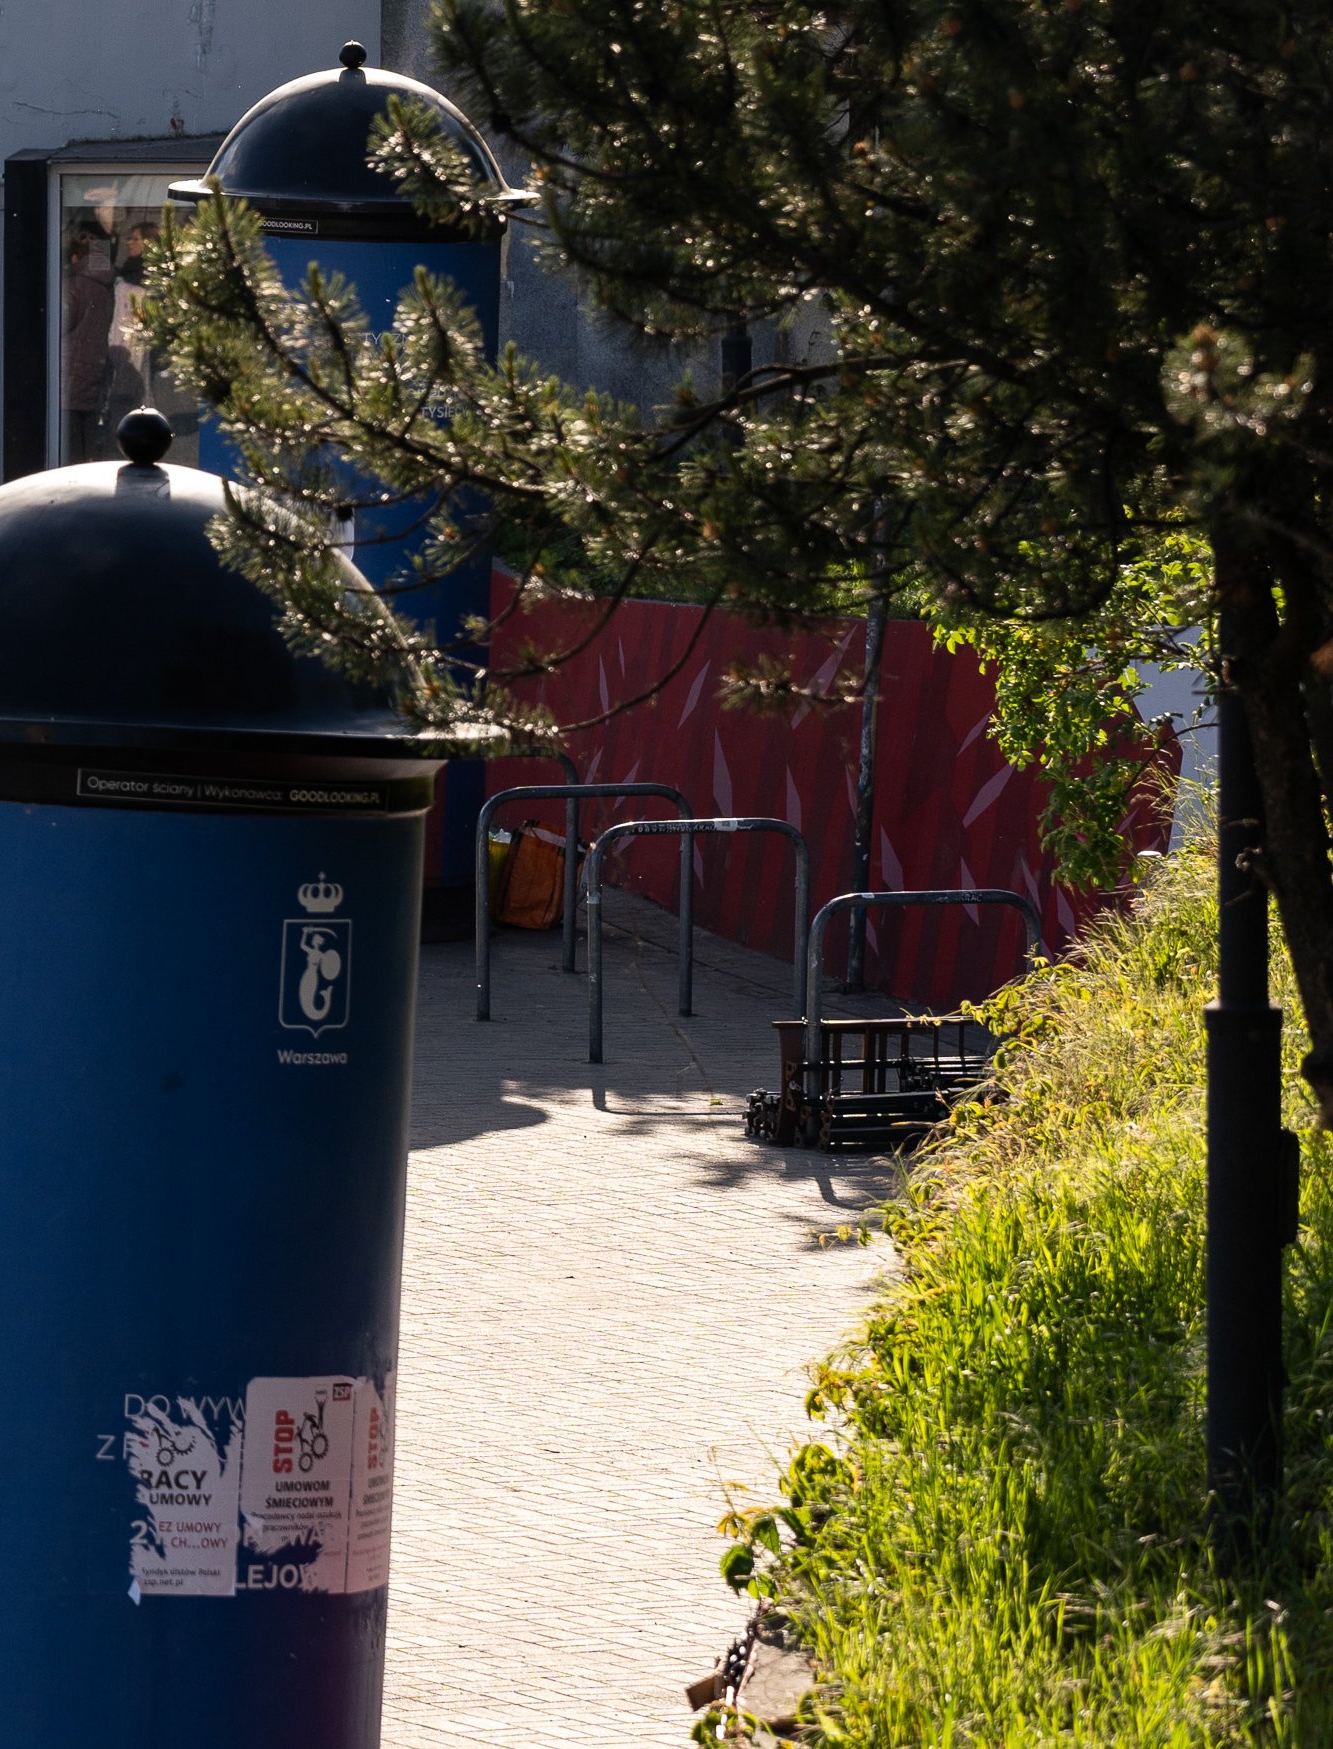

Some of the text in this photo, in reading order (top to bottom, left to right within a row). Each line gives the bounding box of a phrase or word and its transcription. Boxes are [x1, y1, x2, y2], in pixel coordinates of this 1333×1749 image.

[86, 776, 148, 796] Operator
[151, 780, 194, 799] ściany
[277, 1048, 348, 1065] Warszawa
[96, 1434, 116, 1460] Z
[273, 1410, 294, 1474] STOP
[275, 1480, 330, 1492] UMOWOM
[149, 1494, 212, 1506] UMOWY
[265, 1496, 334, 1509] ŚMIECIOWYM
[130, 1520, 148, 1544] 2
[176, 1522, 221, 1533] UMOWY
